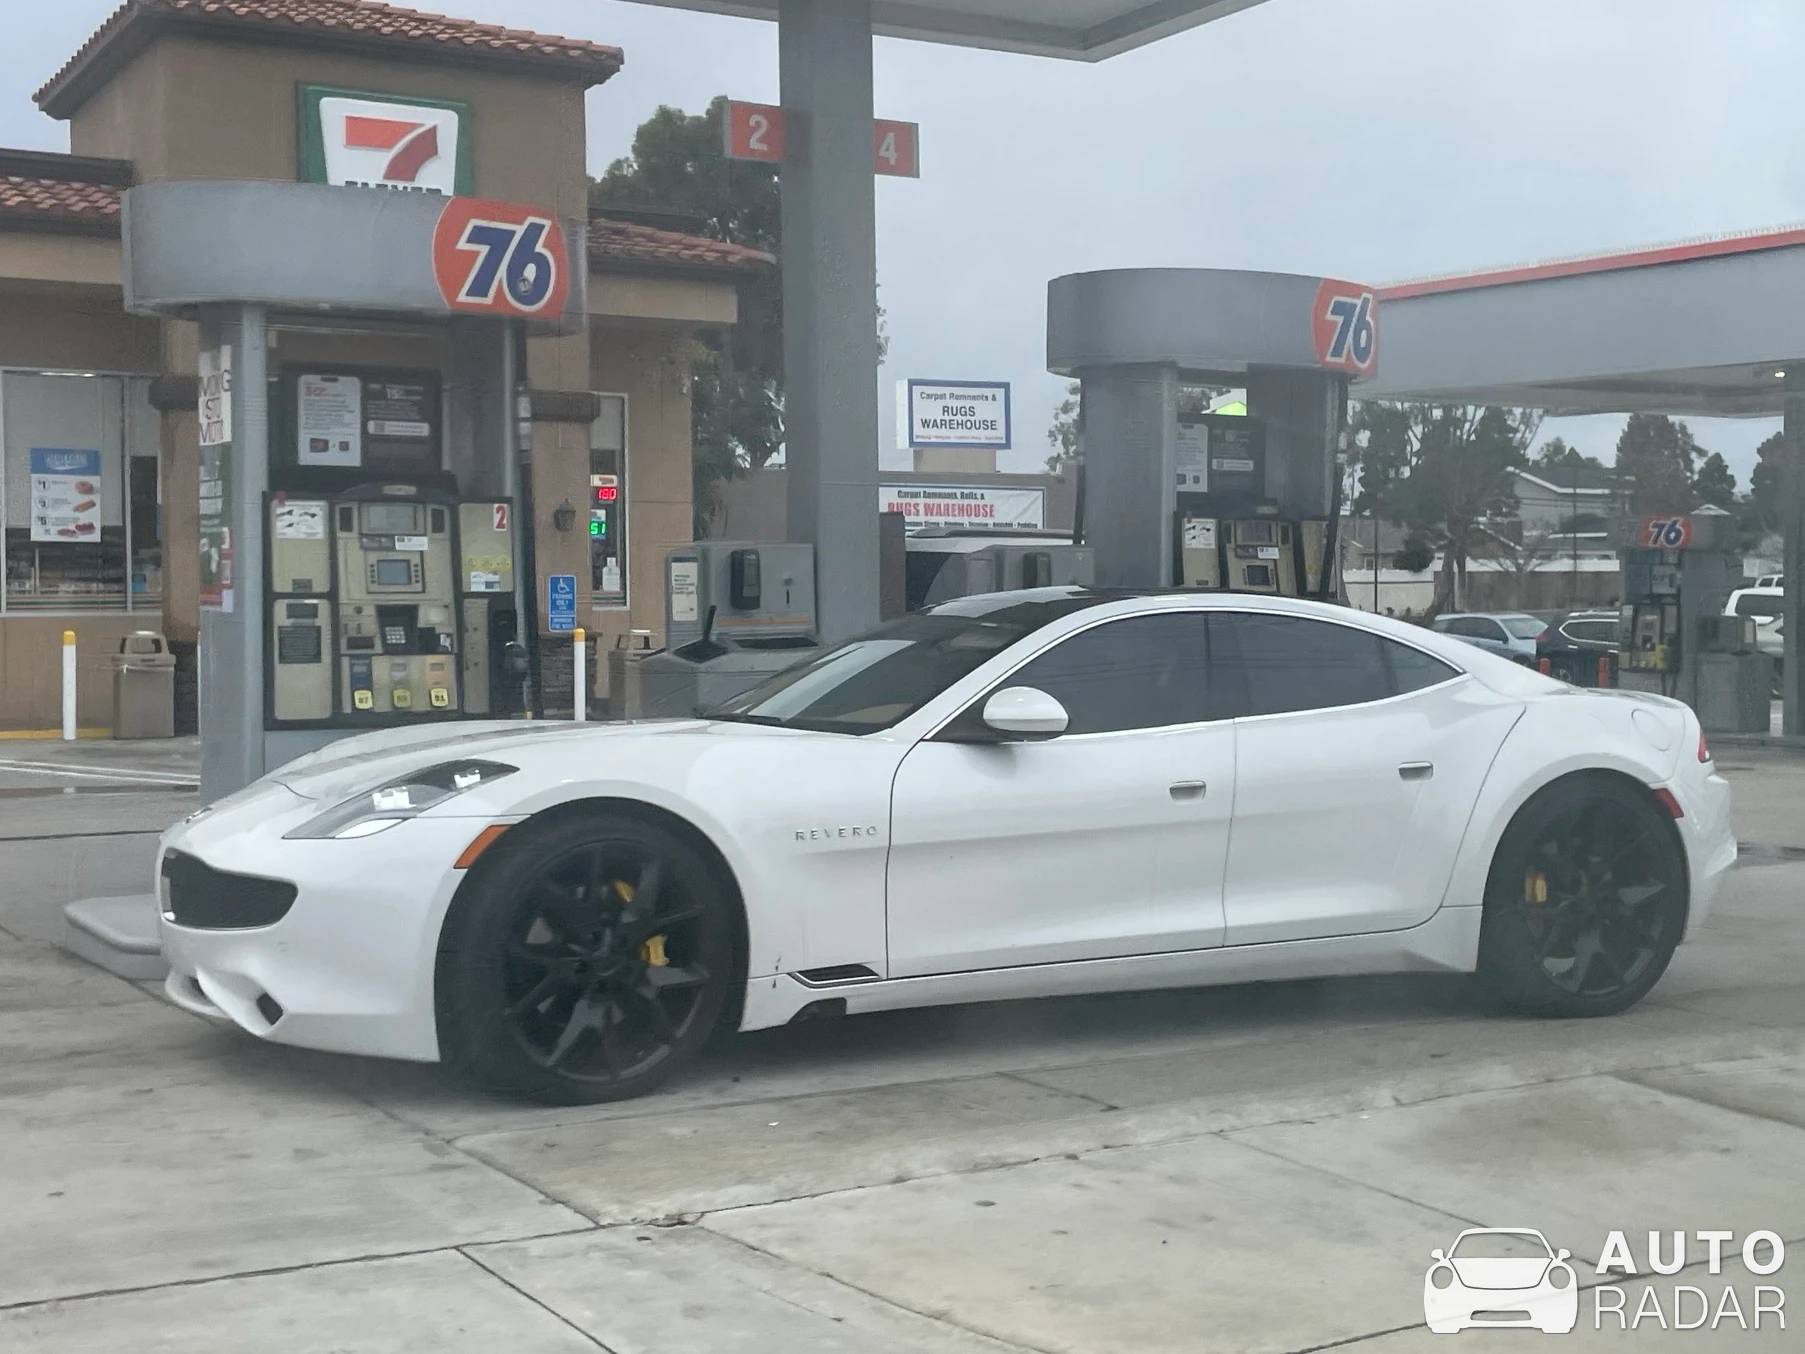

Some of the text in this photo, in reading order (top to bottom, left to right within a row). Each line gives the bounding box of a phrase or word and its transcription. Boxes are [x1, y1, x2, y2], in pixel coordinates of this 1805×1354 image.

[748, 114, 769, 151] 2
[344, 115, 438, 182] 7
[878, 131, 898, 166] 4
[456, 216, 556, 312] 76
[1325, 292, 1373, 368] 76
[919, 391, 997, 402] Carpet Remnants &
[920, 418, 998, 430] WAREHOUSE
[942, 405, 976, 417] RUGS
[495, 504, 507, 530] 2
[923, 503, 995, 518] WAREHOUSE
[1648, 517, 1685, 547] 76
[795, 825, 877, 841] REVERO
